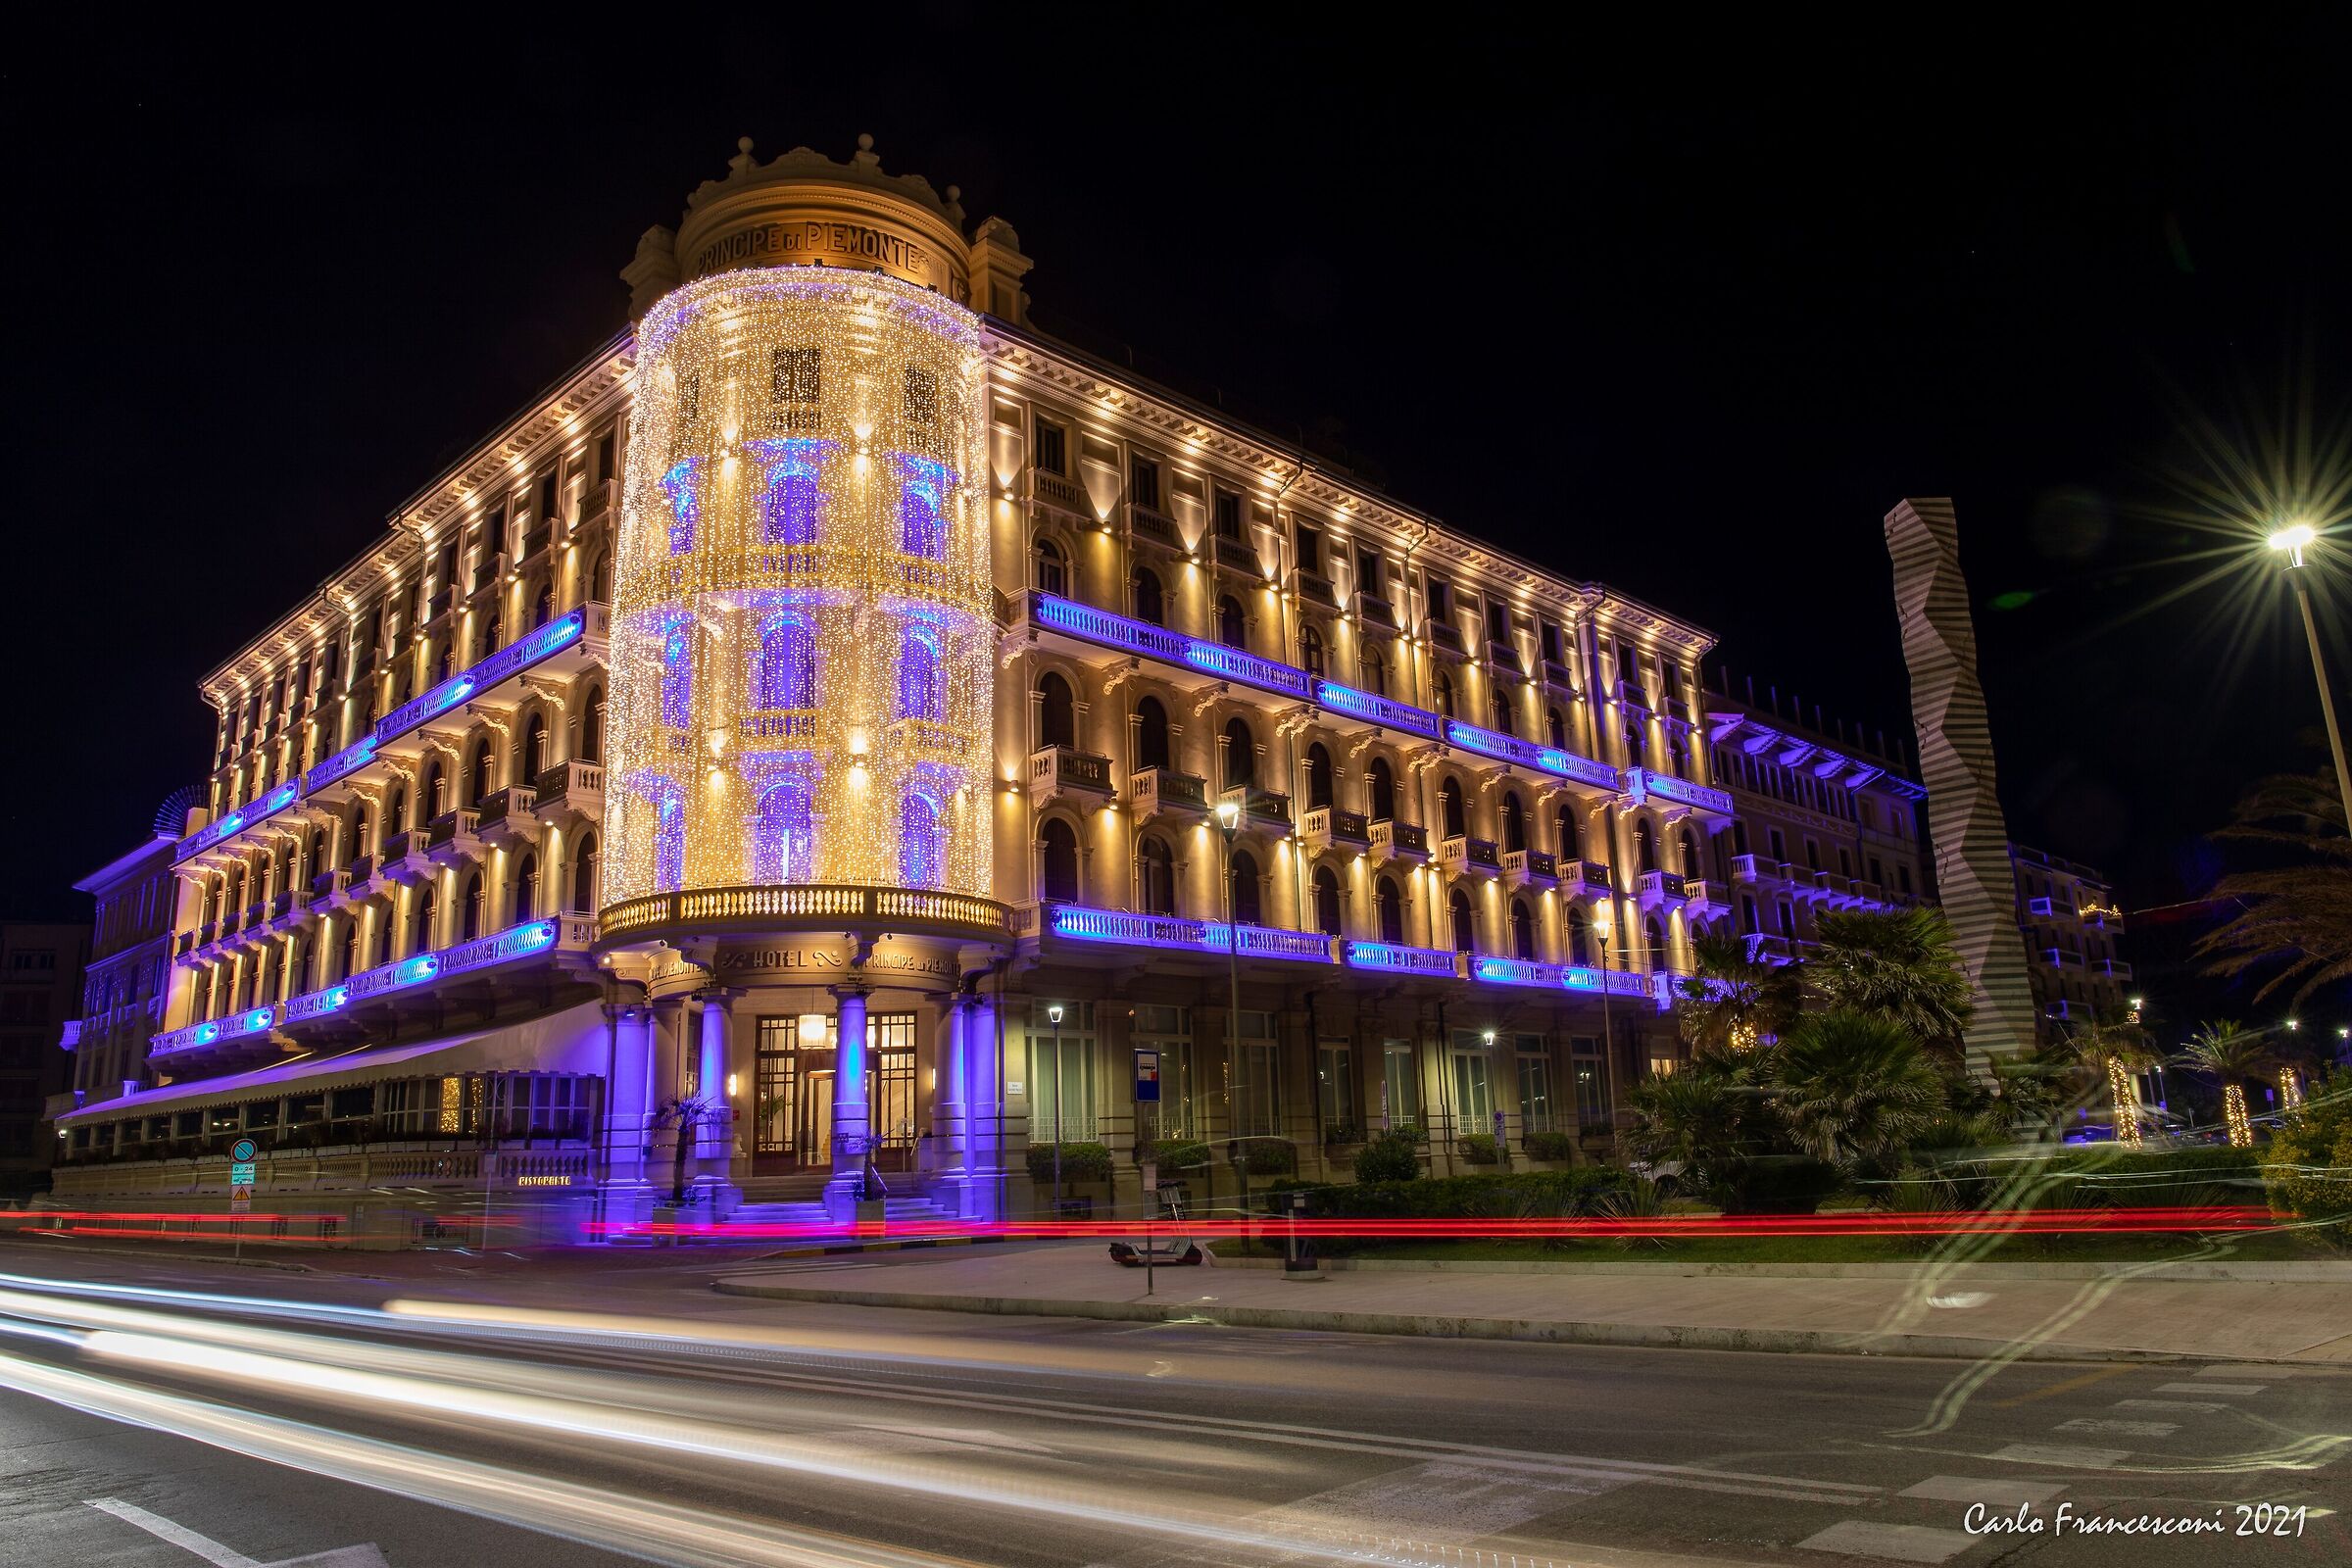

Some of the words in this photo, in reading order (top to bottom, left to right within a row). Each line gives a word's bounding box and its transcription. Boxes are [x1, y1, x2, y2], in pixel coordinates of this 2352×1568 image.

[696, 224, 783, 275] PRINCIPE
[807, 221, 920, 274] PIEMONTE
[753, 950, 808, 968] HOTEL
[517, 1176, 571, 1187] RISTORANTE
